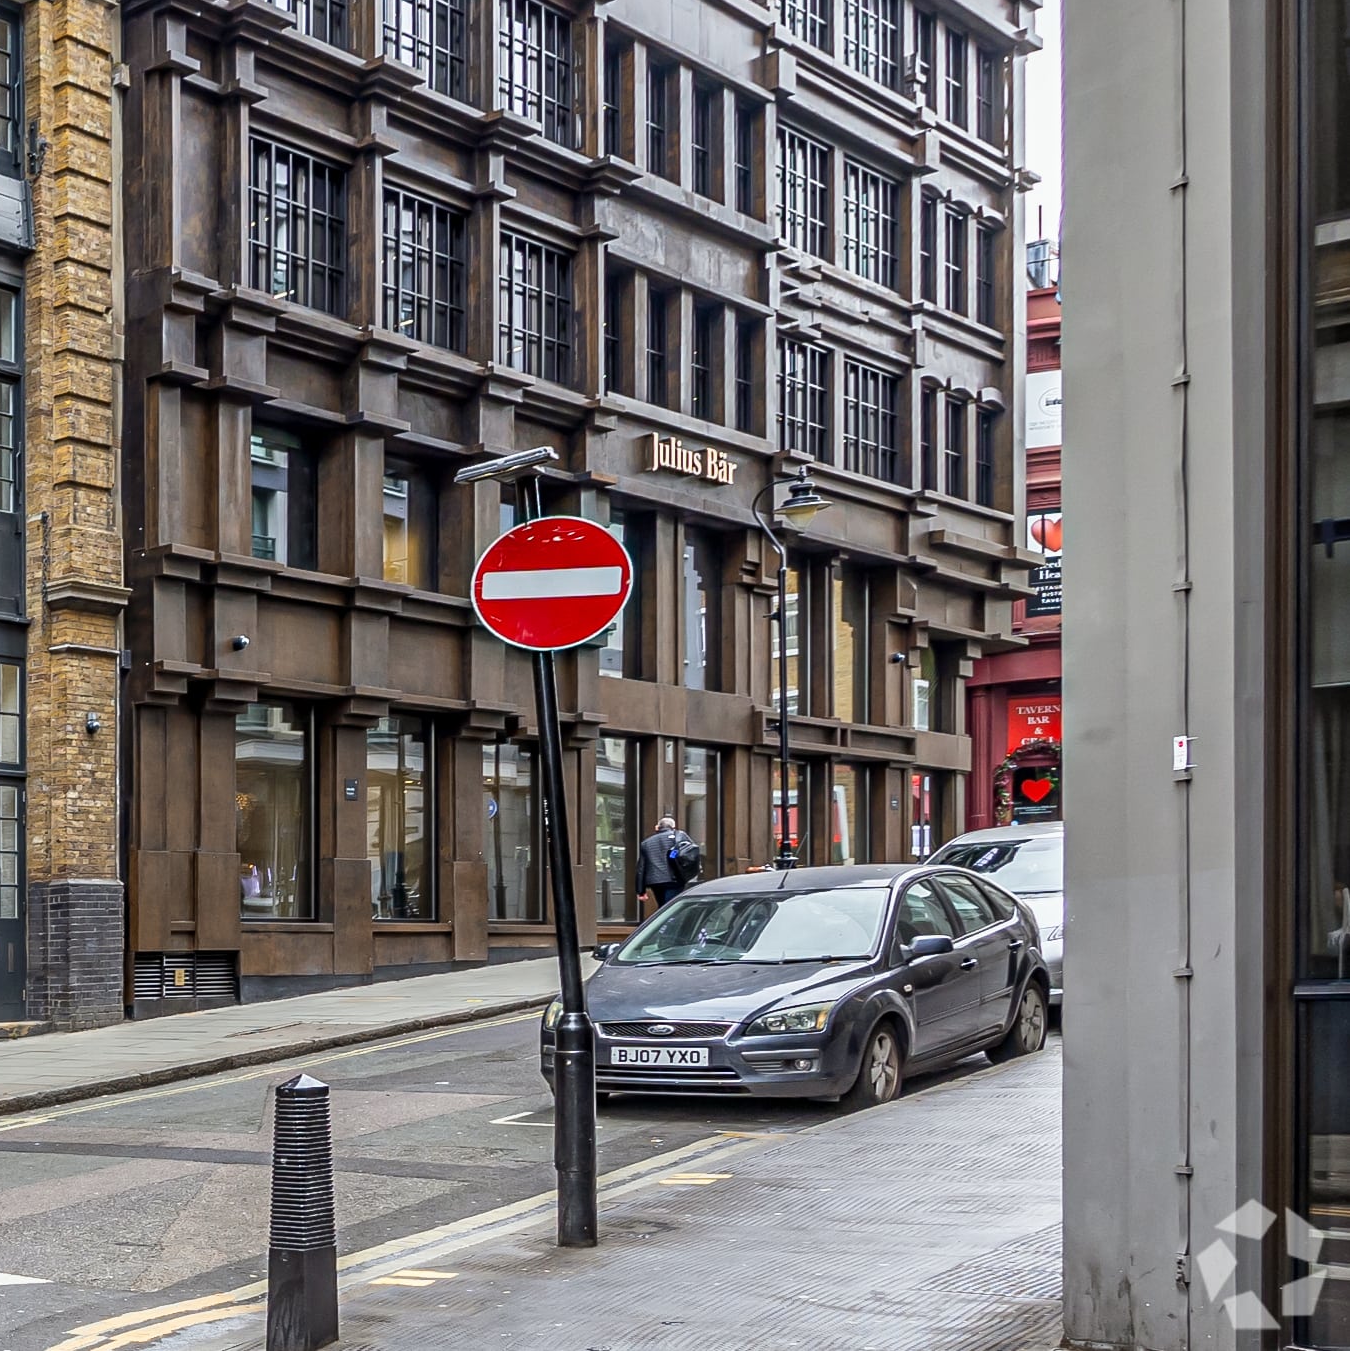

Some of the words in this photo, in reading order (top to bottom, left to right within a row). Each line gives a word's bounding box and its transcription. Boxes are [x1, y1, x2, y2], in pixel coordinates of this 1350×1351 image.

[652, 431, 702, 475] Julius
[706, 447, 738, 485] Bär
[1016, 705, 1061, 715] TAVERN
[1027, 716, 1050, 725] BAR
[1034, 726, 1043, 735] &
[618, 1049, 661, 1063] BJ07
[666, 1049, 701, 1064] YXO
